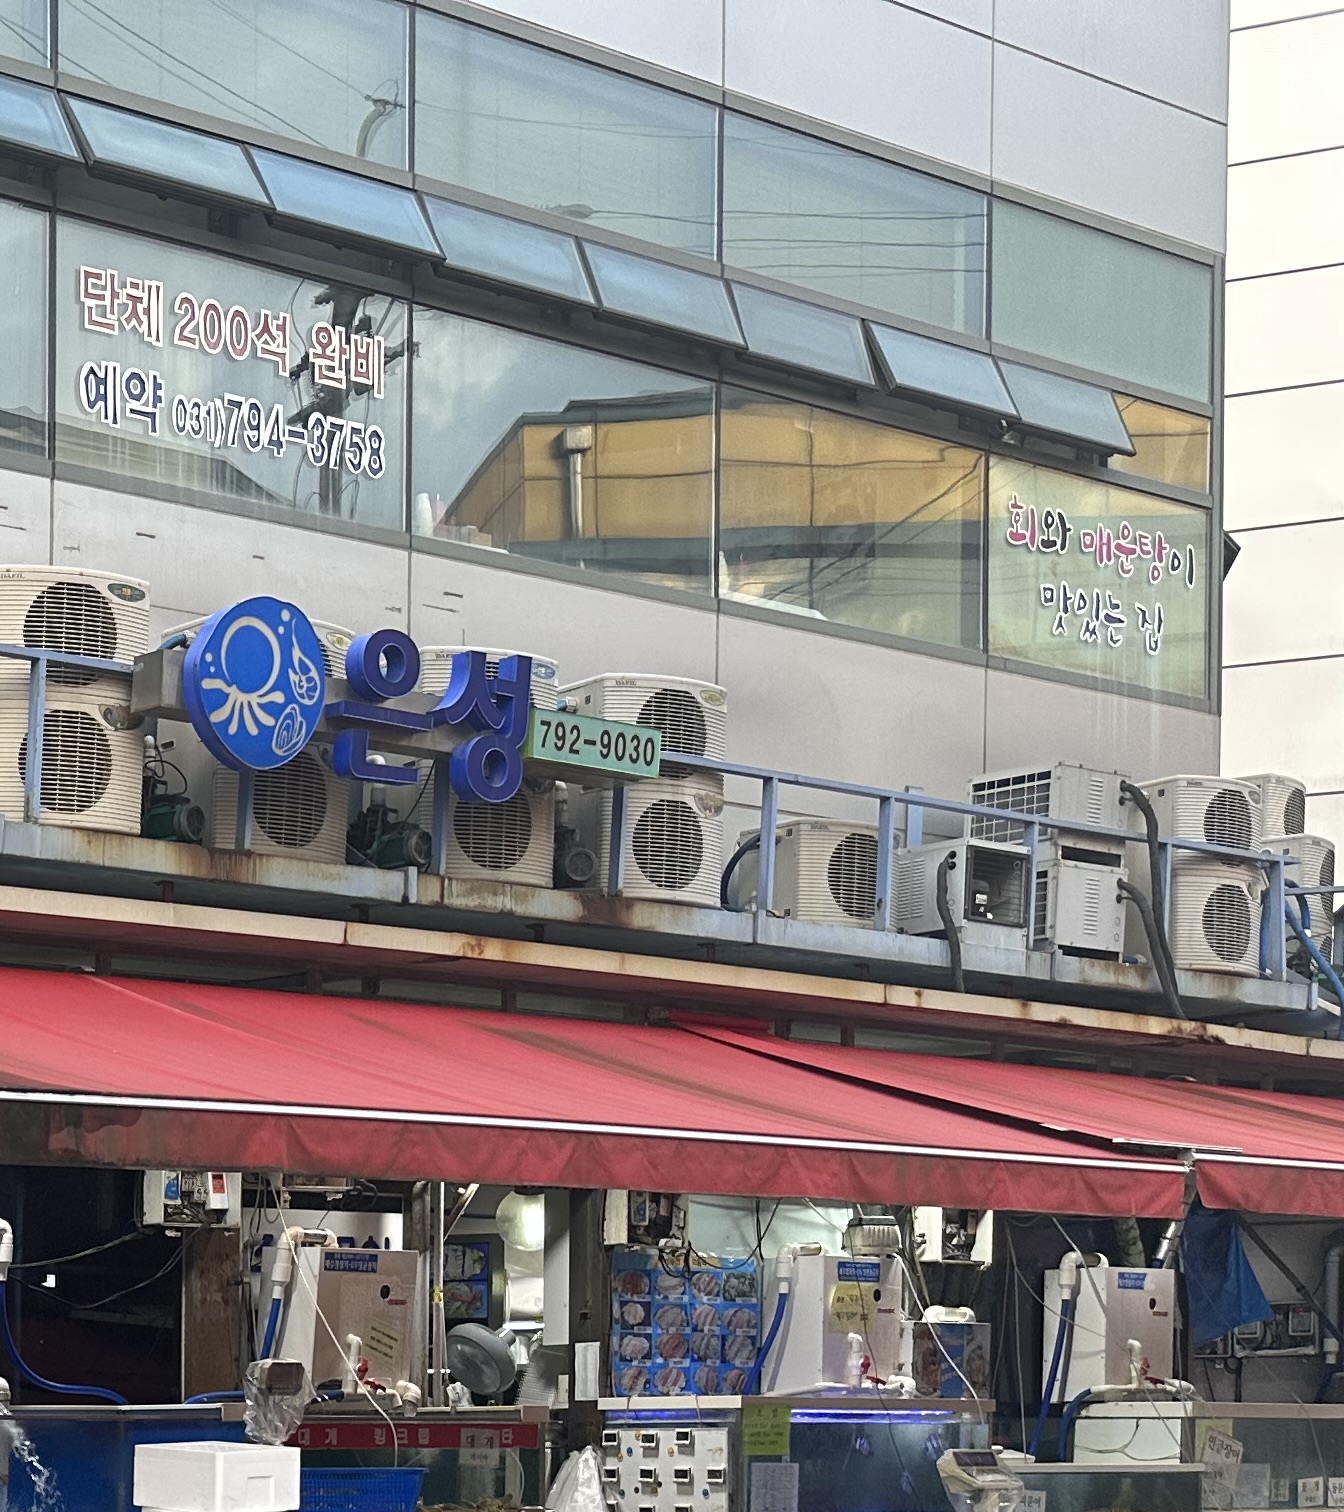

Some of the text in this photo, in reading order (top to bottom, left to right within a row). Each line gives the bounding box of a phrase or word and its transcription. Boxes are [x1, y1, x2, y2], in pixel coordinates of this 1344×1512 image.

[78, 265, 386, 398] 단체 200석 완비
[79, 360, 387, 480] 예약 031)794-3758
[1006, 494, 1196, 589] 회와 매운탕이
[1040, 583, 1165, 657] 맛있는 집
[325, 628, 533, 803] 은성
[539, 719, 656, 768] 792-9030
